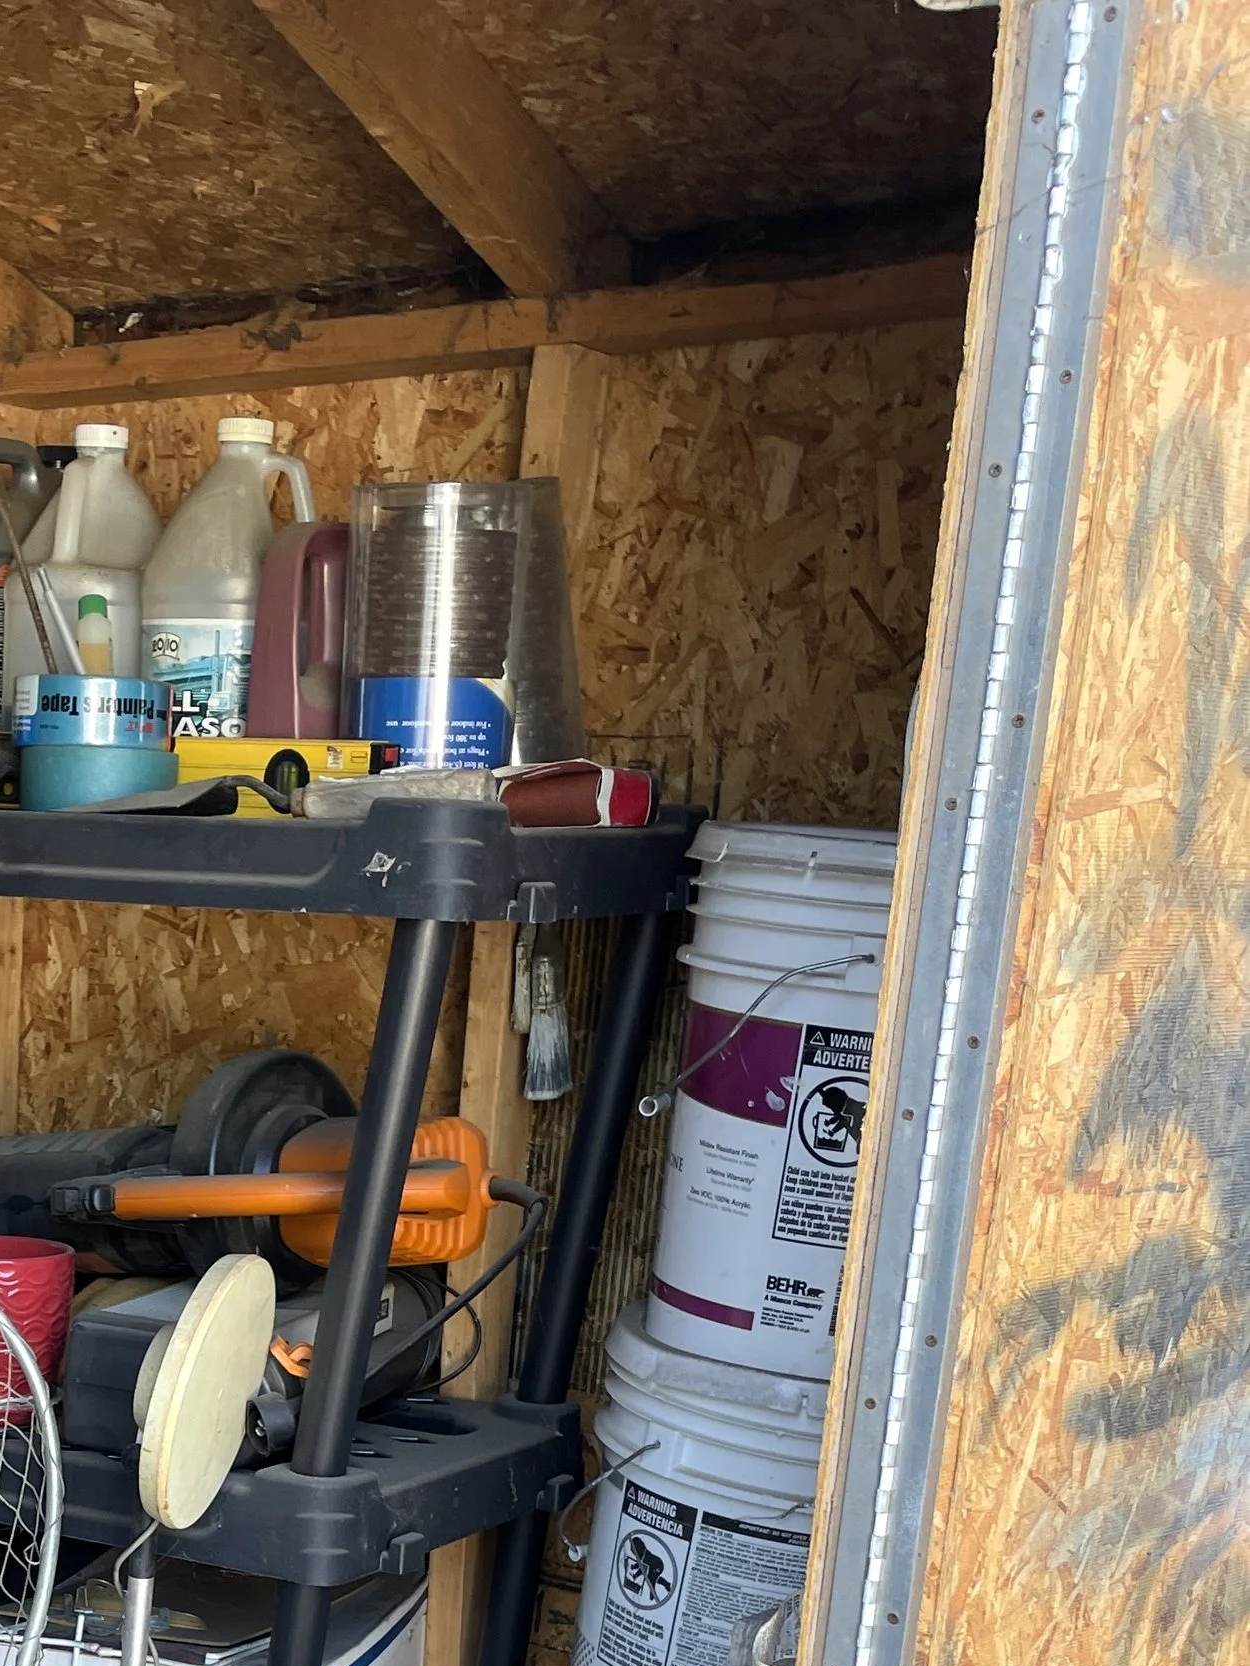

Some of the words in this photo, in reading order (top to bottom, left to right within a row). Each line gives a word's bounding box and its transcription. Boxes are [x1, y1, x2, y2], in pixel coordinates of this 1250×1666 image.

[41, 694, 79, 715] Tape
[84, 696, 155, 719] Painters
[172, 716, 248, 738] ASO
[830, 1033, 873, 1052] WARNI
[813, 1050, 871, 1070] ADVERTE
[766, 1275, 808, 1296] BEHR
[793, 1300, 823, 1311] Company
[637, 1490, 677, 1518] WARNING
[627, 1503, 683, 1537] ADVERTENCIA
